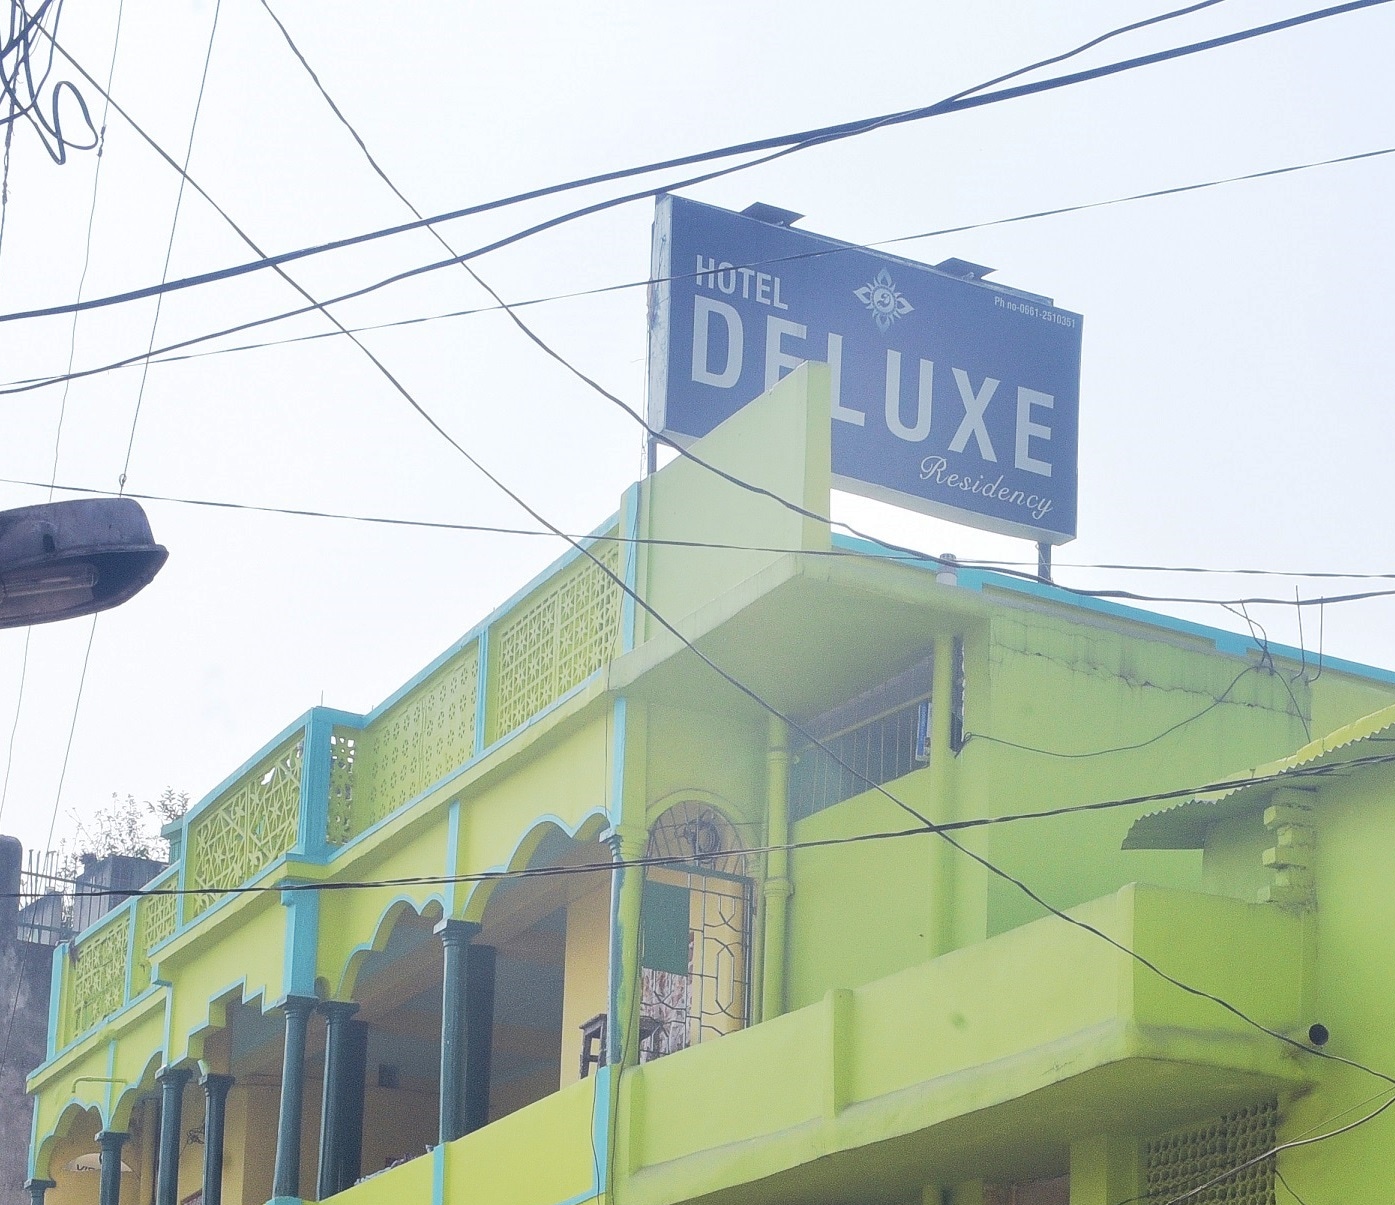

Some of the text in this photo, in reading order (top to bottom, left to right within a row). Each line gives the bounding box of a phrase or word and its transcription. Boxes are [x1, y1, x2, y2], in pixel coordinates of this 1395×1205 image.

[696, 255, 788, 310] HOTEL
[995, 296, 1005, 307] Ph
[691, 295, 1055, 476] DELUXE
[920, 455, 1053, 519] Residency
